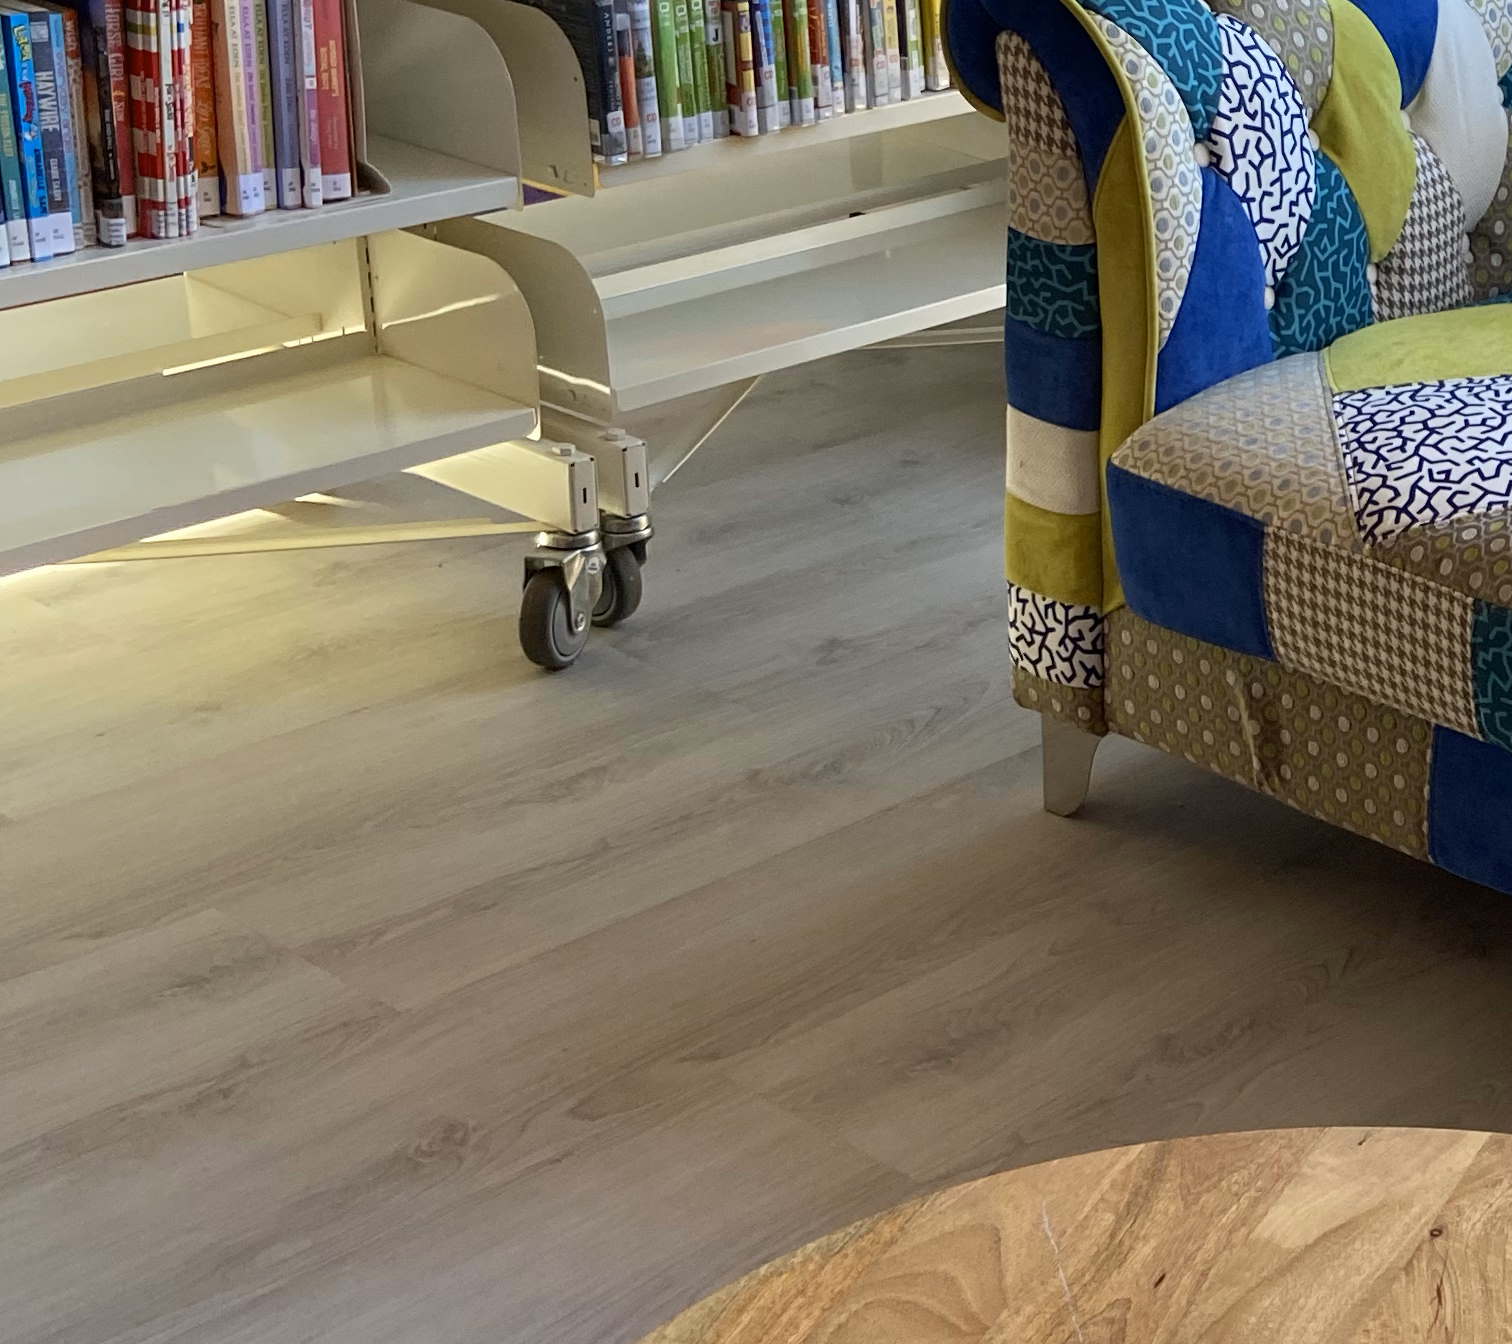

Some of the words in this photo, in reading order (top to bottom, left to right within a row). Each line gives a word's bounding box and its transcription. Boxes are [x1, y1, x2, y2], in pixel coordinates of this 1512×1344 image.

[228, 6, 238, 27] ELLA
[242, 6, 250, 27] ELLA
[255, 3, 263, 25] ELLA
[281, 4, 289, 25] ELLA
[105, 4, 124, 52] HORSE
[231, 42, 240, 68] EDEN
[244, 42, 253, 67] EDEN
[257, 39, 265, 65] EDEN
[108, 53, 126, 81] GIRL
[34, 70, 60, 132] HAYWIRE
